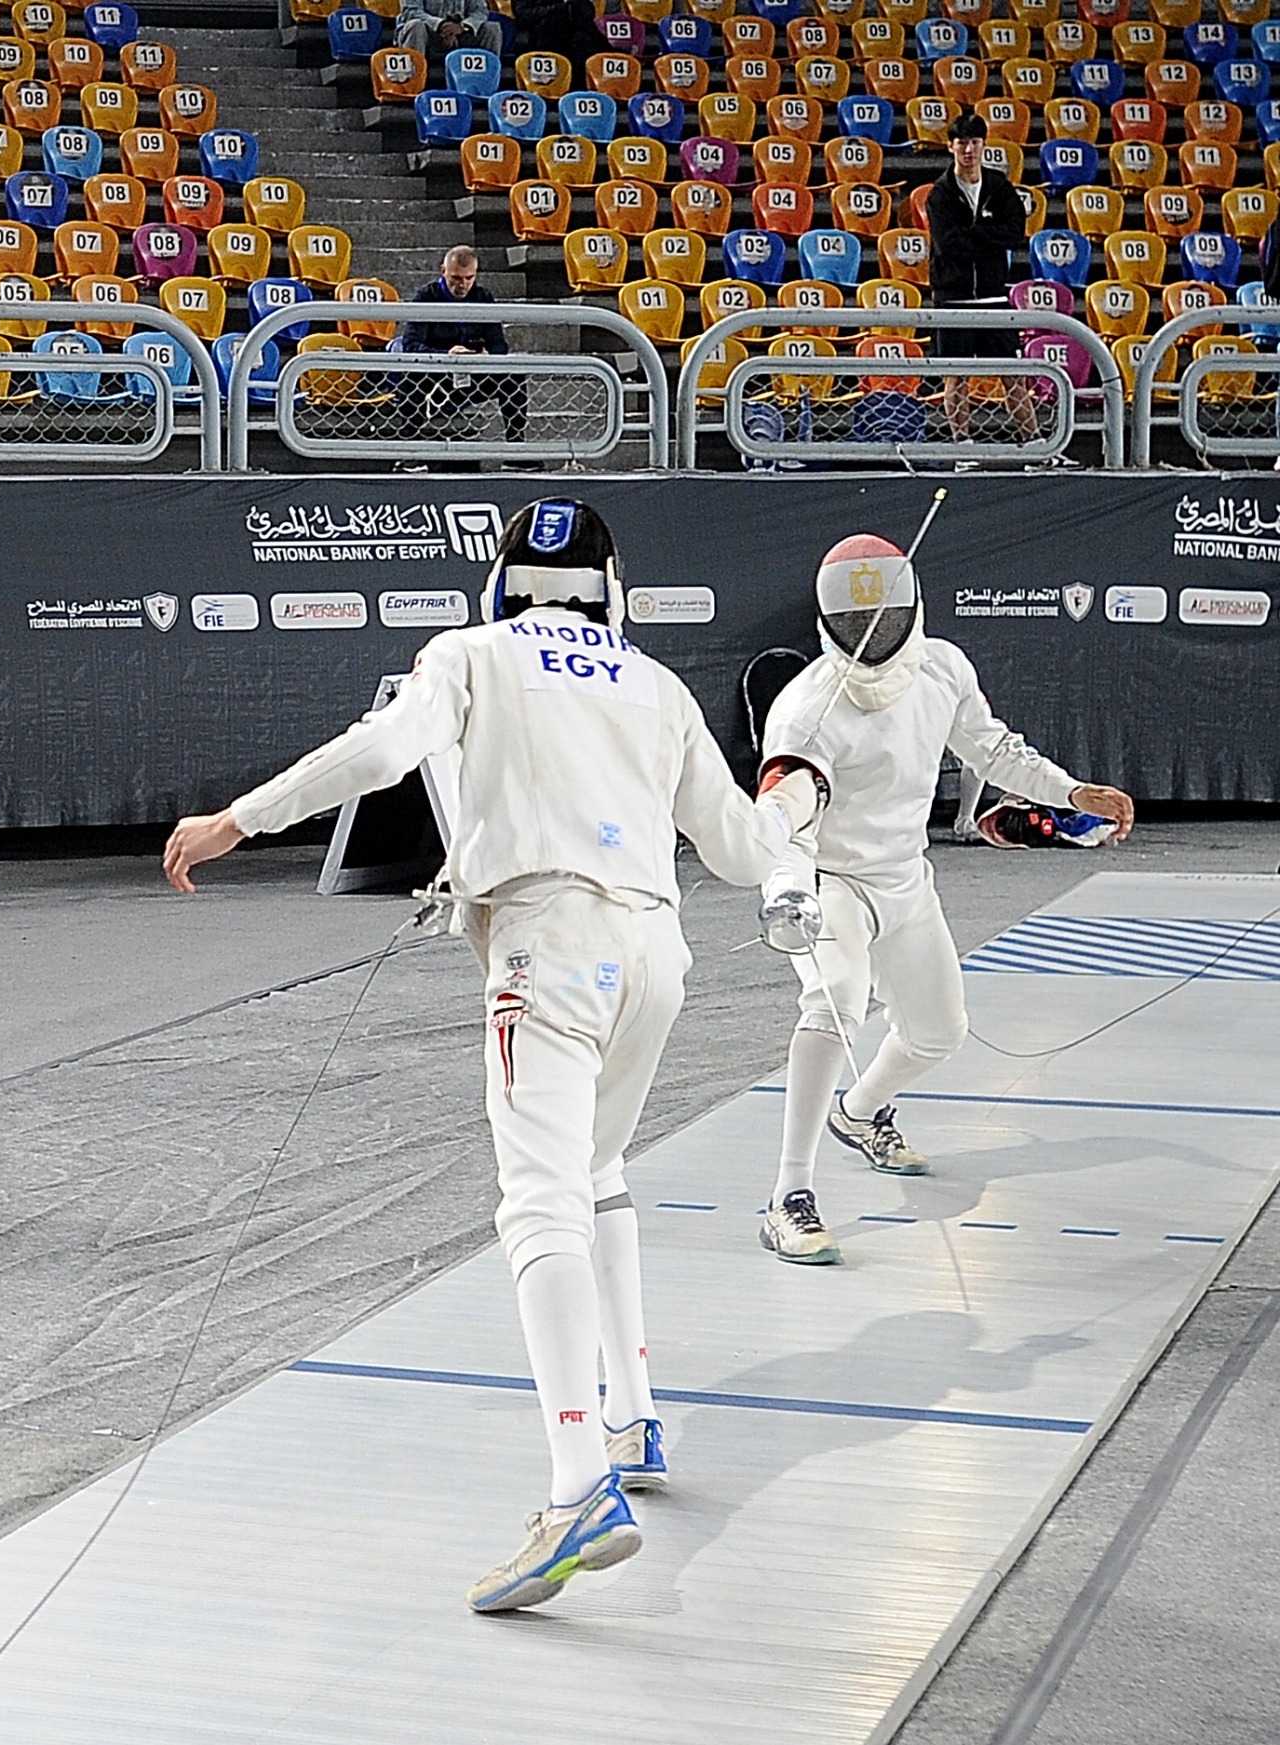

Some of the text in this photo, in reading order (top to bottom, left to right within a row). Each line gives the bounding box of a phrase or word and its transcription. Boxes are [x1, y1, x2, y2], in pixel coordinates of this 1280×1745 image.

[31, 8, 49, 21] 10
[99, 10, 115, 22] 11
[346, 17, 363, 30] 01
[610, 24, 628, 36] 05
[675, 23, 693, 36] 06
[870, 24, 887, 37] 09
[739, 25, 756, 37] 07
[805, 29, 823, 42] 08
[68, 47, 86, 61] 10
[141, 49, 156, 62] 11
[389, 57, 406, 70] 01
[464, 57, 483, 70] 02
[606, 61, 624, 75] 04
[745, 63, 763, 75] 06
[882, 64, 900, 77] 08
[814, 66, 832, 79] 07
[954, 66, 972, 79] 09
[1021, 70, 1038, 83] 10
[24, 91, 44, 105] 08
[99, 91, 118, 105] 09
[180, 93, 198, 106] 10
[718, 98, 736, 111] 05
[434, 100, 451, 113] 01
[510, 102, 529, 116] 02
[578, 100, 598, 114] 03
[785, 102, 804, 115] 06
[857, 106, 875, 119] 07
[924, 105, 942, 118] 08
[993, 106, 1011, 119] 09
[1130, 106, 1144, 119] 11
[63, 136, 83, 151] 08
[141, 136, 160, 150] 09
[219, 139, 237, 153] 10
[480, 144, 498, 159] 01
[557, 145, 576, 159] 02
[627, 148, 647, 162] 03
[700, 147, 719, 161] 04
[772, 146, 791, 160] 05
[845, 147, 864, 162] 06
[984, 149, 1003, 162] 08
[1060, 150, 1079, 164] 09
[1200, 150, 1214, 163] 11
[105, 186, 126, 201] 08
[182, 184, 201, 199] 09
[265, 186, 284, 200] 10
[531, 190, 549, 205] 01
[617, 190, 638, 205] 02
[773, 192, 792, 206] 04
[854, 194, 873, 209] 05
[1086, 195, 1104, 210] 08
[1165, 197, 1183, 211] 09
[1242, 197, 1261, 211] 10
[77, 234, 97, 250] 07
[154, 236, 175, 251] 08
[231, 235, 251, 252] 09
[312, 239, 332, 253] 10
[665, 239, 686, 253] 02
[901, 238, 922, 253] 05
[1199, 237, 1218, 252] 09
[1050, 243, 1070, 258] 07
[1125, 243, 1145, 258] 08
[4, 285, 26, 301] 05
[96, 286, 117, 302] 06
[183, 292, 203, 308] 07
[270, 288, 291, 304] 08
[642, 292, 661, 306] 01
[723, 291, 744, 306] 02
[799, 291, 820, 307] 03
[880, 291, 900, 306] 04
[1032, 290, 1053, 306] 06
[1110, 292, 1130, 308] 07
[147, 347, 169, 364] 06
[253, 544, 447, 562] NATIONAL BANK OF EGYPT
[1174, 540, 1280, 562] NATIONAL BAN
[1114, 606, 1133, 618] FIE
[204, 614, 224, 627] FIE
[539, 649, 623, 683] EGY
